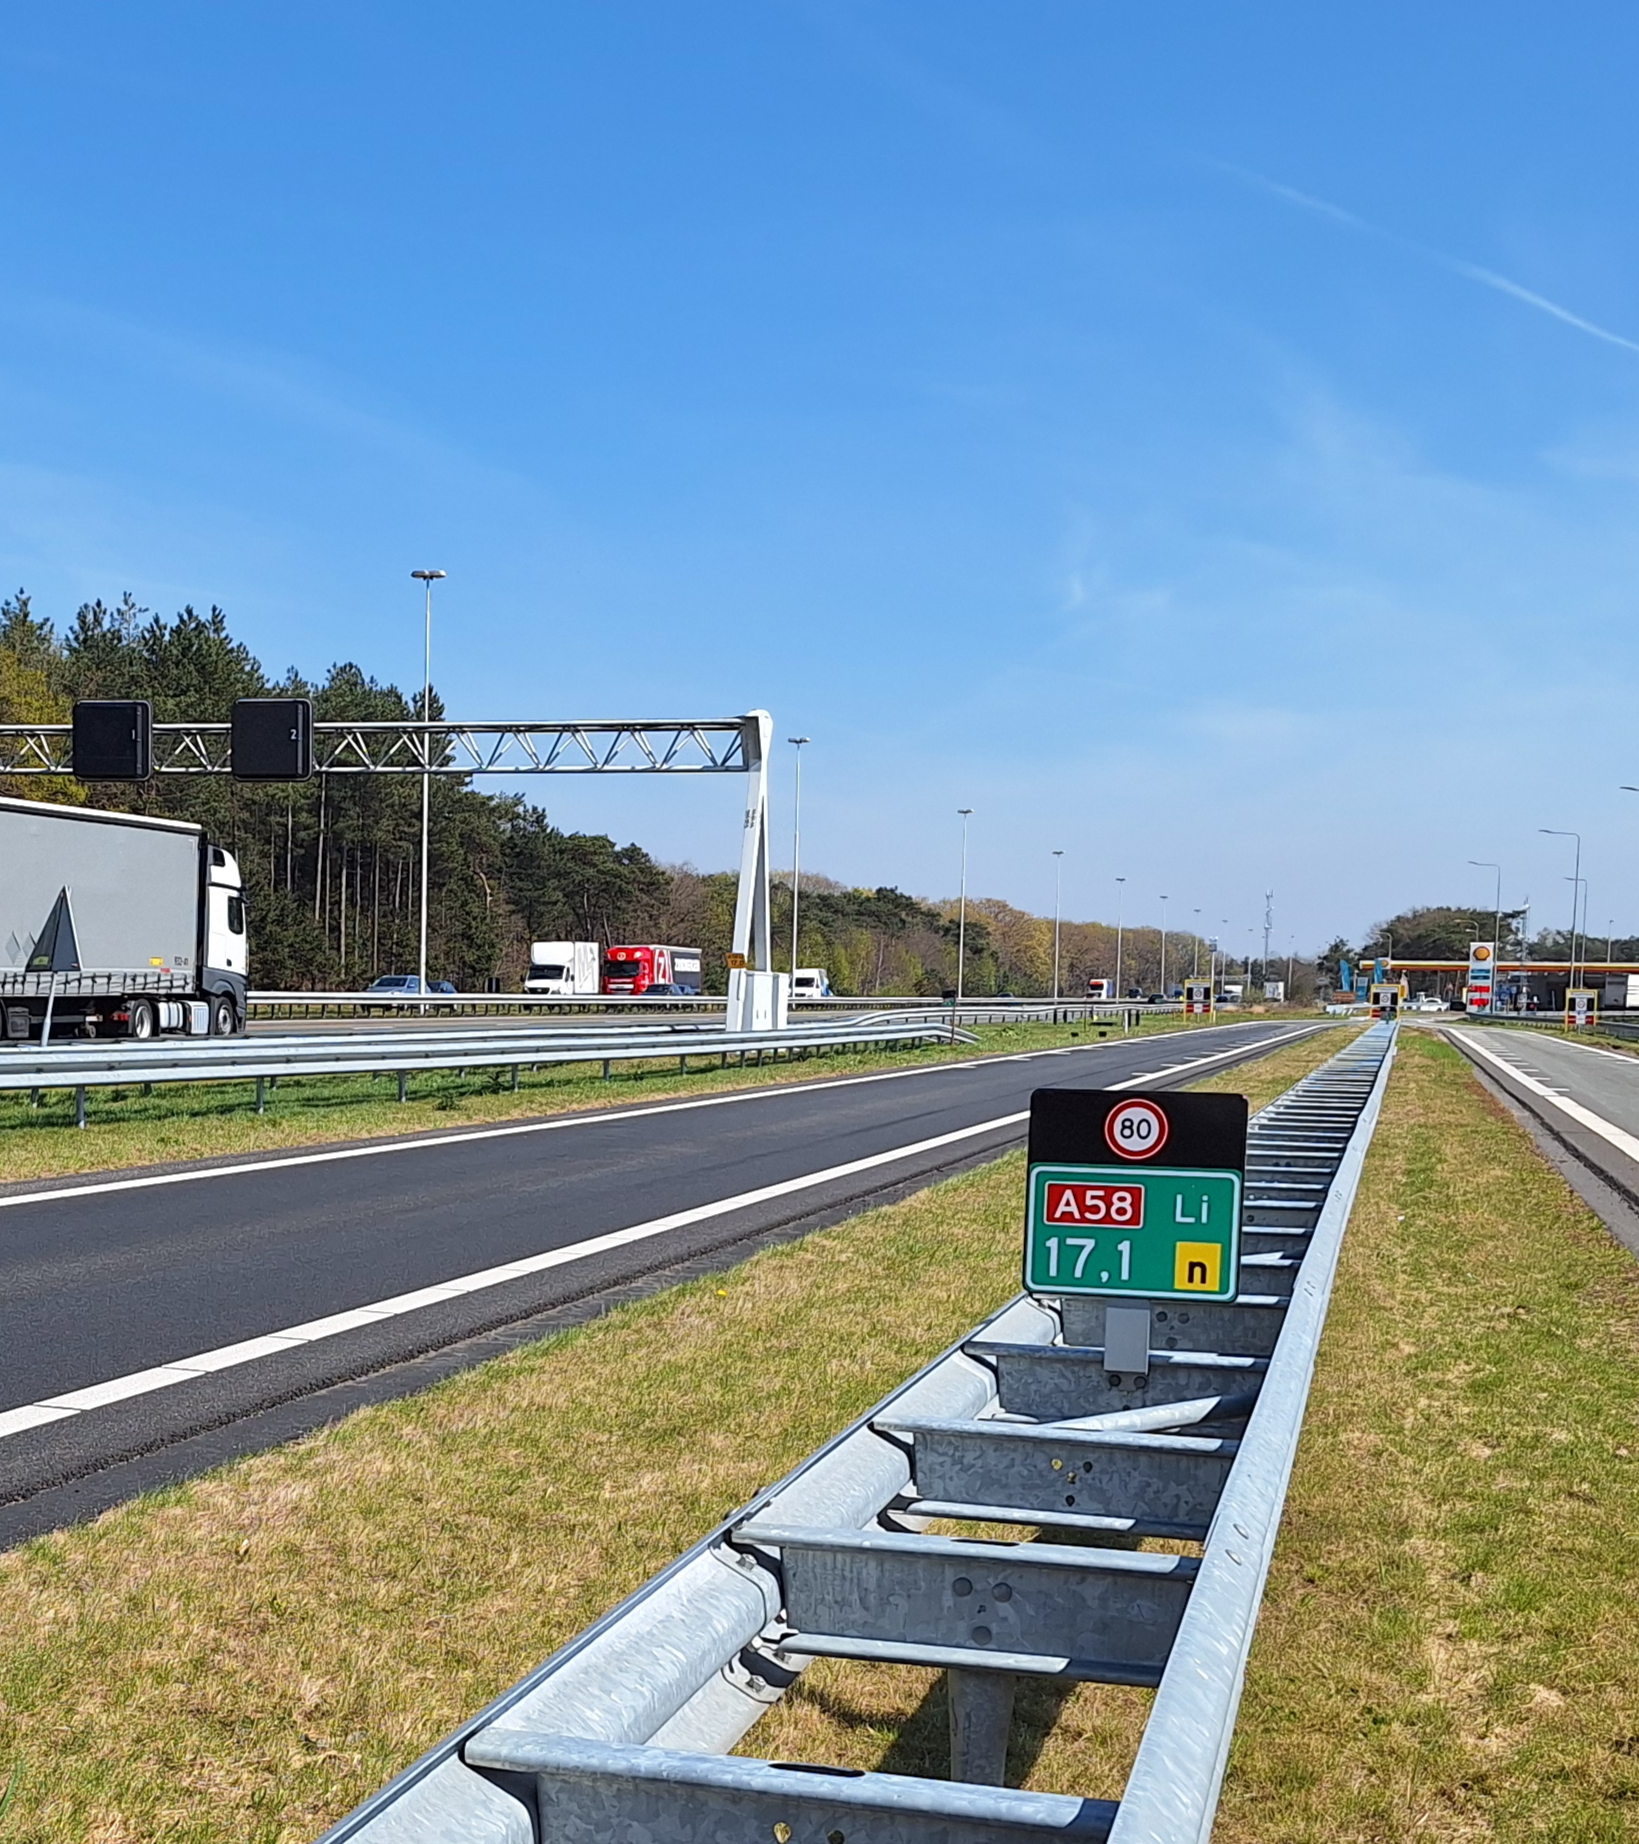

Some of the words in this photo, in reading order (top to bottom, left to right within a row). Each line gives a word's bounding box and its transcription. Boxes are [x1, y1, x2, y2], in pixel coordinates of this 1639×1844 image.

[1119, 1117, 1152, 1140] 80
[1053, 1188, 1133, 1222] A58
[1174, 1193, 1209, 1224] Li
[1044, 1236, 1131, 1284] 17,1
[1186, 1259, 1208, 1285] n
